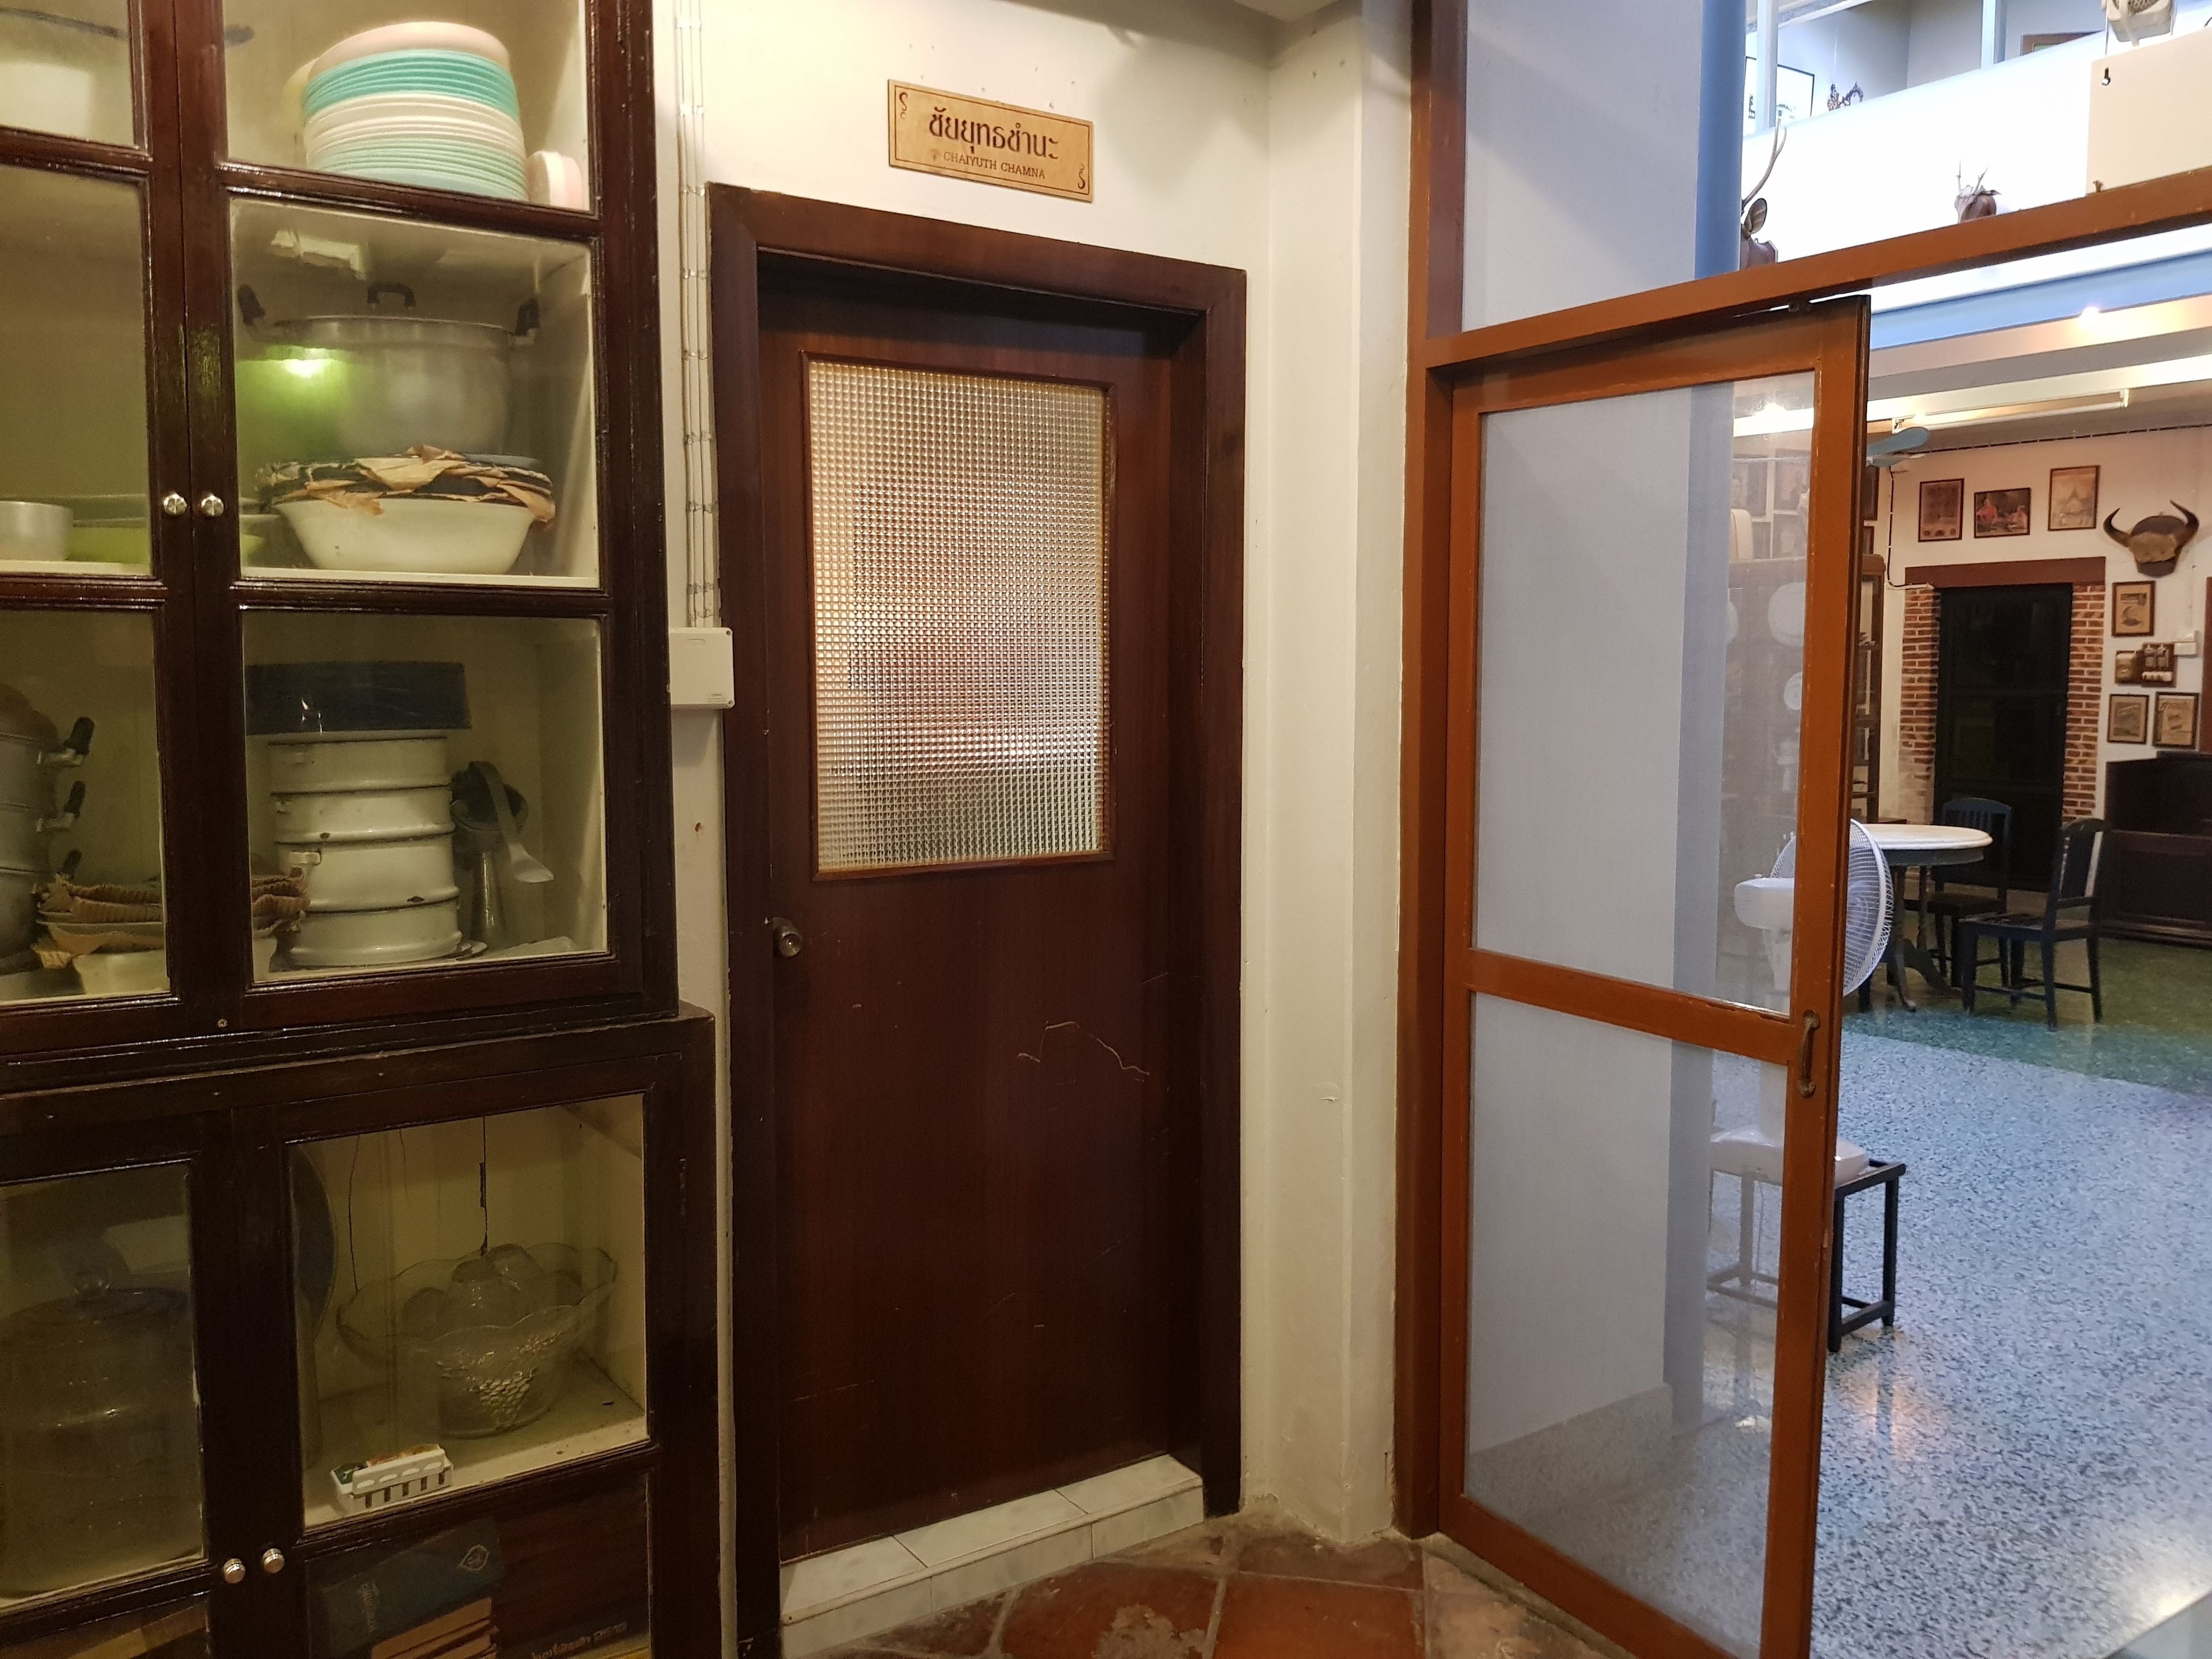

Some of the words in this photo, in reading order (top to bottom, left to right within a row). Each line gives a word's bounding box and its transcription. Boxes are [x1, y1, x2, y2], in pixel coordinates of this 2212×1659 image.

[929, 107, 1059, 160] ชัยยุทธชำนะ
[944, 151, 997, 171] CHAIYUTH
[1001, 162, 1046, 179] CHAMNA
